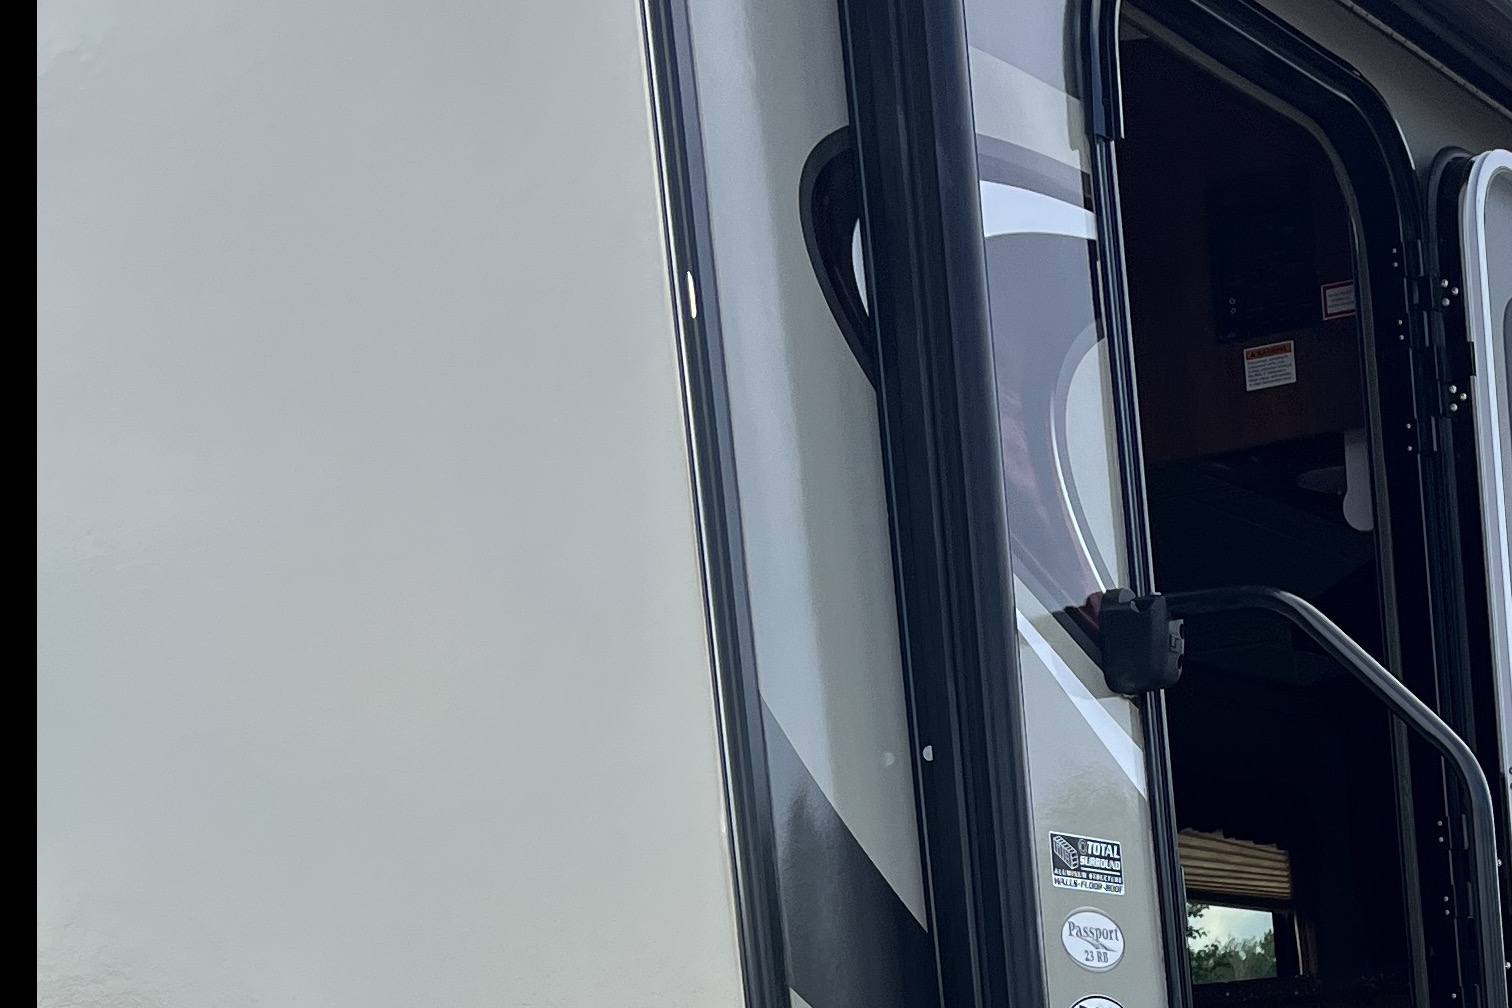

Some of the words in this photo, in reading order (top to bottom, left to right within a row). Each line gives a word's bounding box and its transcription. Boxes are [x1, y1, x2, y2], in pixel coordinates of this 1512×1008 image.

[1087, 841, 1121, 859] TOTAL
[1080, 856, 1121, 870] SURROUND
[1067, 920, 1120, 943] Passport
[1084, 949, 1095, 962] 23
[1096, 950, 1109, 963] RB
